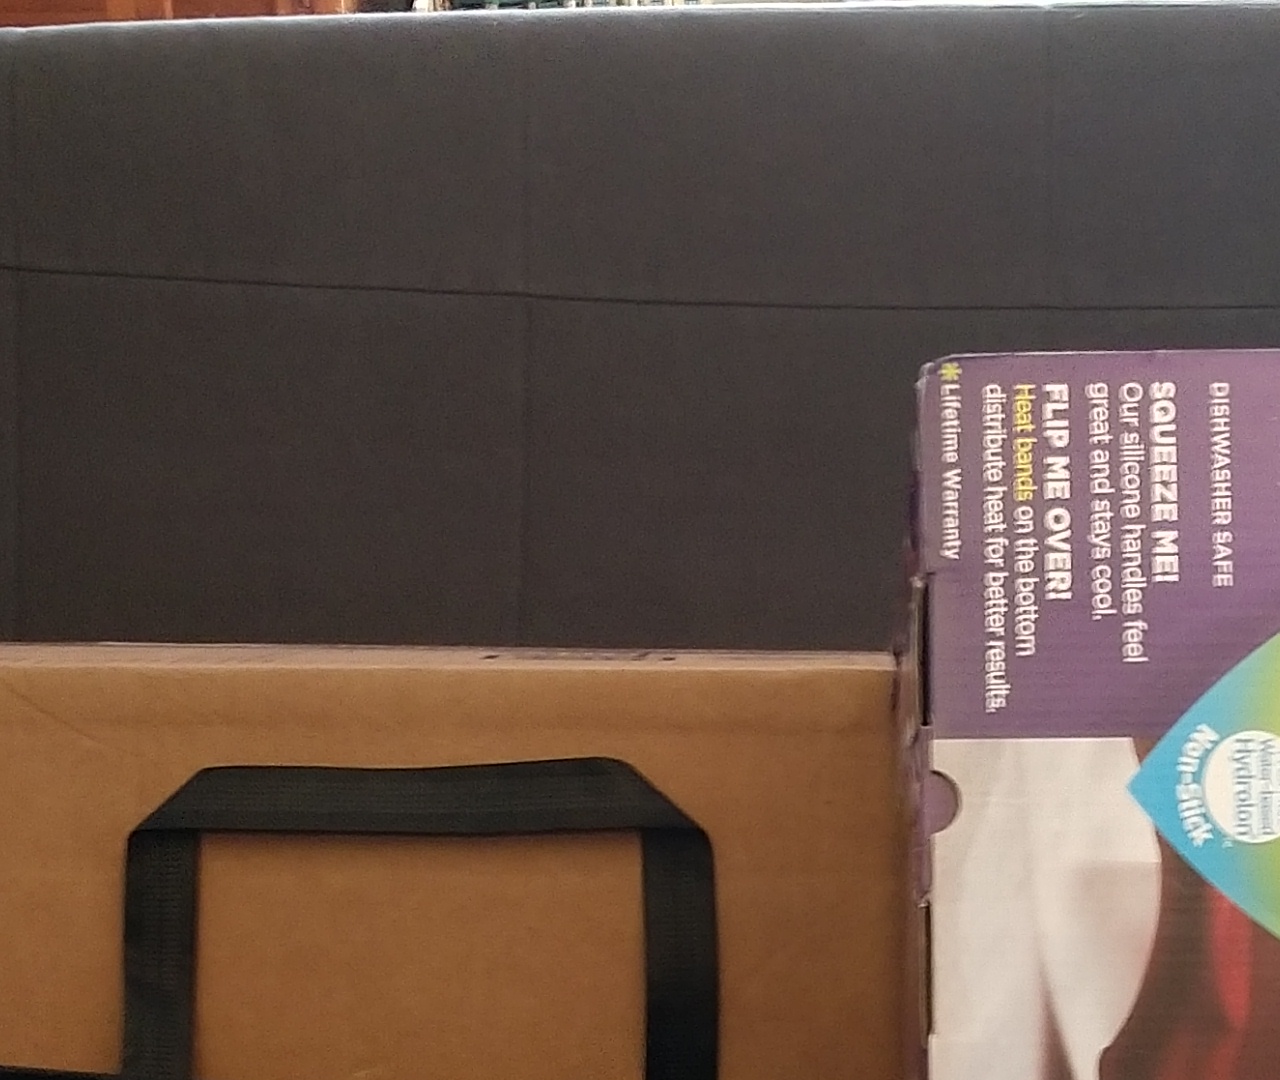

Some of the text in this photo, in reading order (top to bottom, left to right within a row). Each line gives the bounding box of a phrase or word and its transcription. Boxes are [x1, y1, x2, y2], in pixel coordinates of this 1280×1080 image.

[939, 469, 962, 559] Warranty
[980, 384, 1010, 712] distribute heat for better results.
[1012, 384, 1038, 656] Heat bands on the bottom
[1041, 383, 1072, 600] FLIP ME OVER!
[1085, 383, 1116, 620] great and stays cool.
[1119, 382, 1148, 662] Our silicone handles feel
[1149, 382, 1179, 582] SQUEEZE ME!
[1208, 382, 1234, 588] DISHWASHER SAFE
[1175, 724, 1220, 846] Non-Stick
[1226, 738, 1257, 836] Hydrolon
